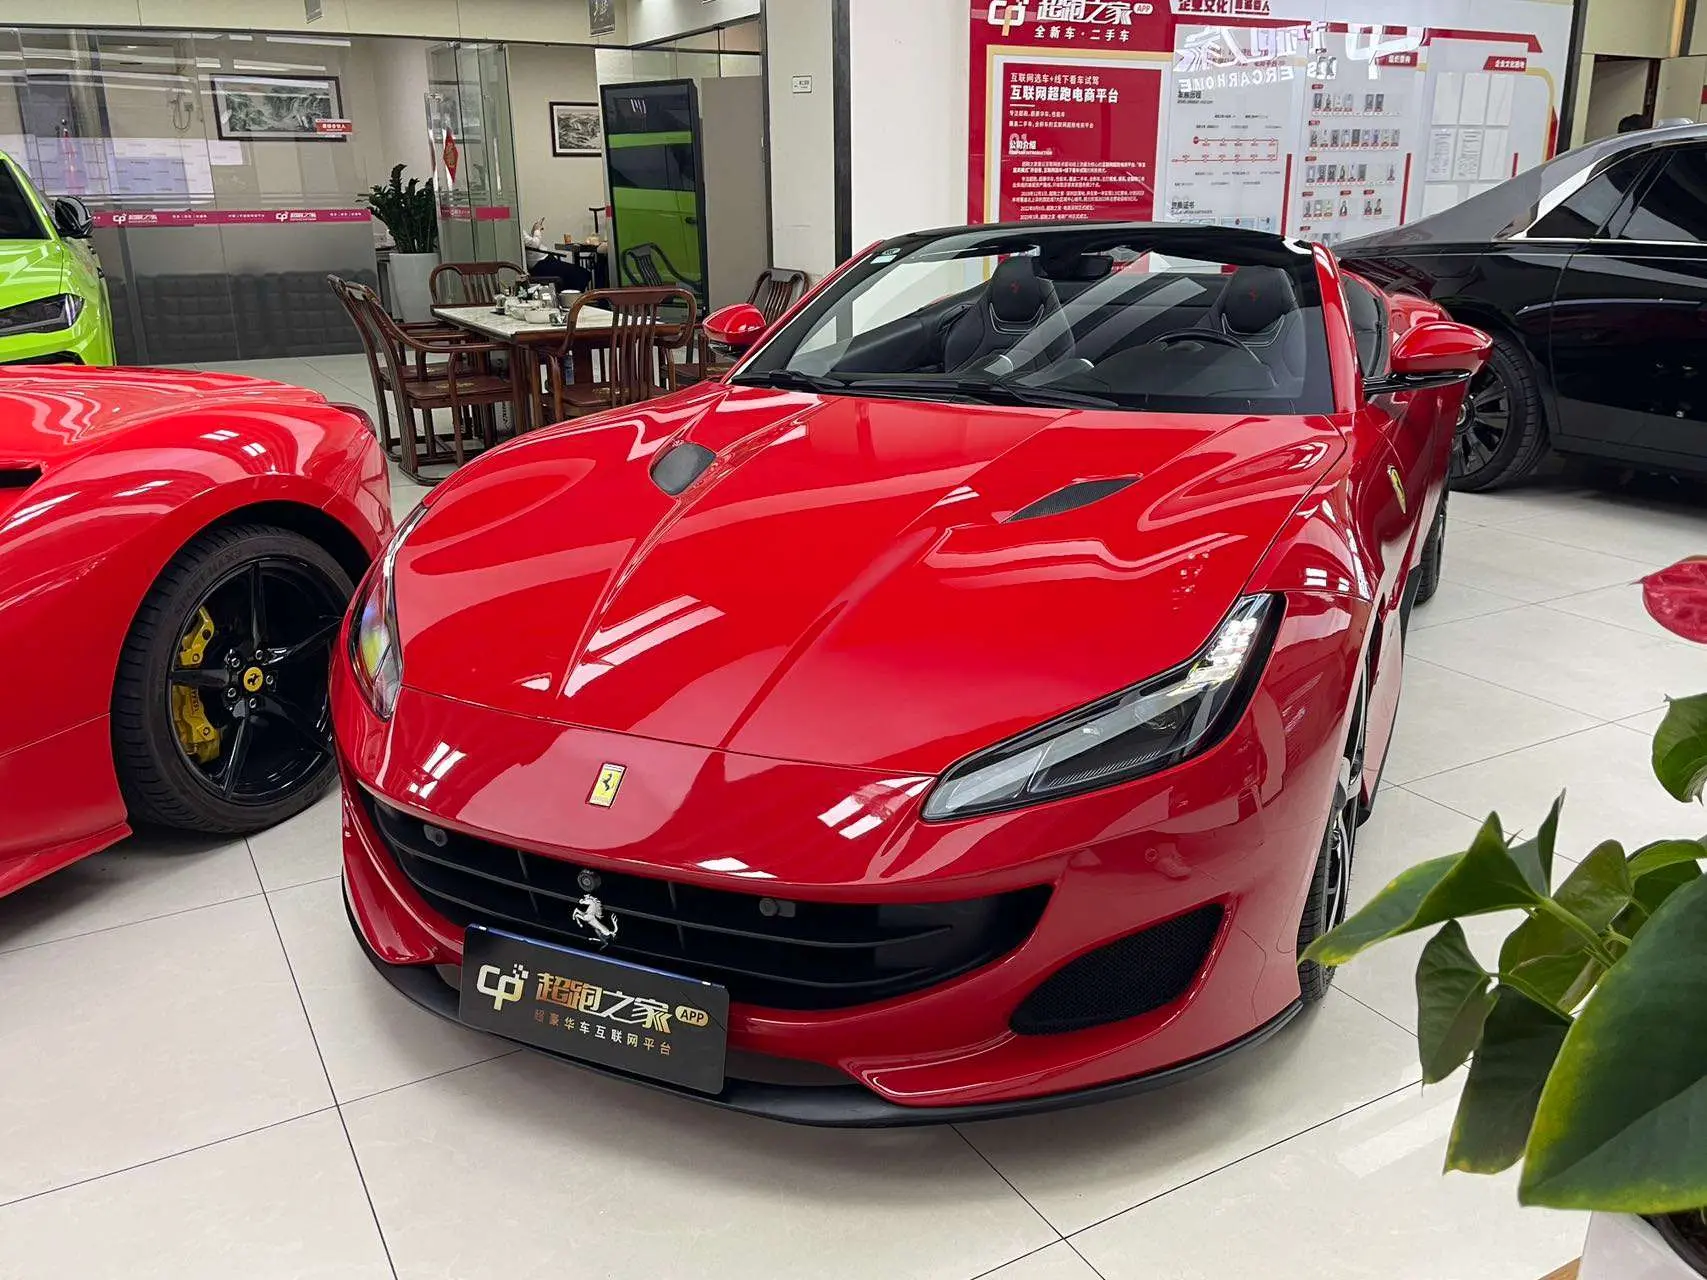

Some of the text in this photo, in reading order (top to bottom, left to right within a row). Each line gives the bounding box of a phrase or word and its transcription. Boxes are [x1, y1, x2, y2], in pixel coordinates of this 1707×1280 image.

[1036, 0, 1150, 25] 超跑之家 APP
[1010, 84, 1119, 104] 互联网超跑电商平台
[536, 972, 705, 1034] 超跑之家 APP
[534, 1009, 672, 1056] 超豪华车互联网平台
